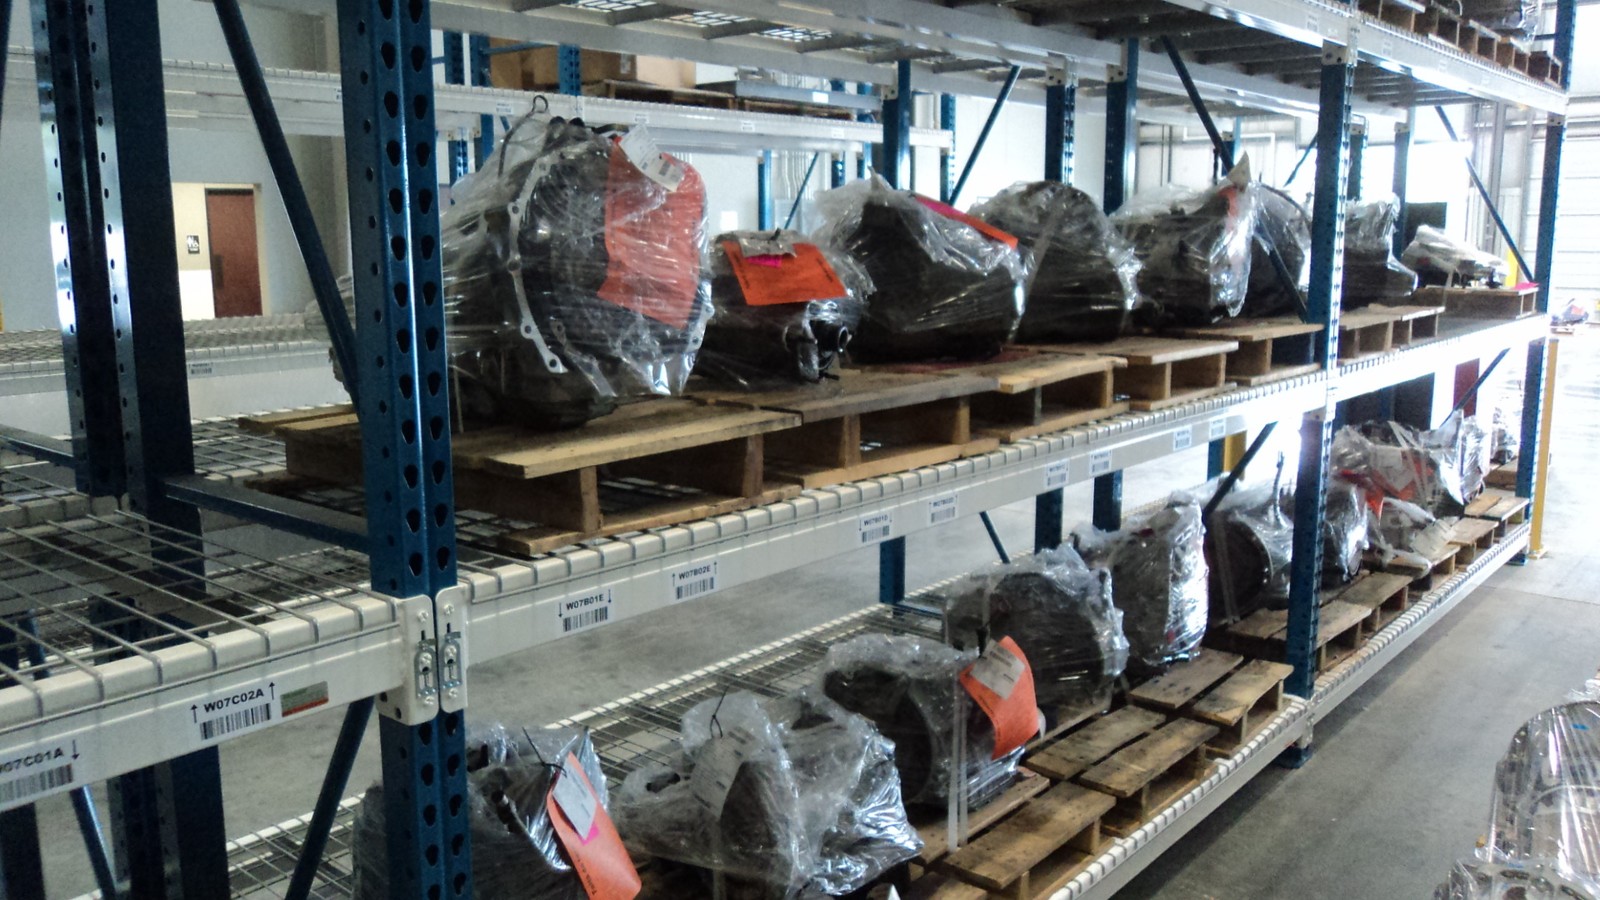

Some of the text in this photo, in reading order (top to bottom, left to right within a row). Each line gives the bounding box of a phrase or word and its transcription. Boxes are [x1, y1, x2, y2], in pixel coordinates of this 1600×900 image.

[679, 564, 711, 580] W07B02E
[566, 594, 604, 610] W07B01E
[204, 688, 264, 712] W07C02A
[0, 748, 64, 773] 07C01A
